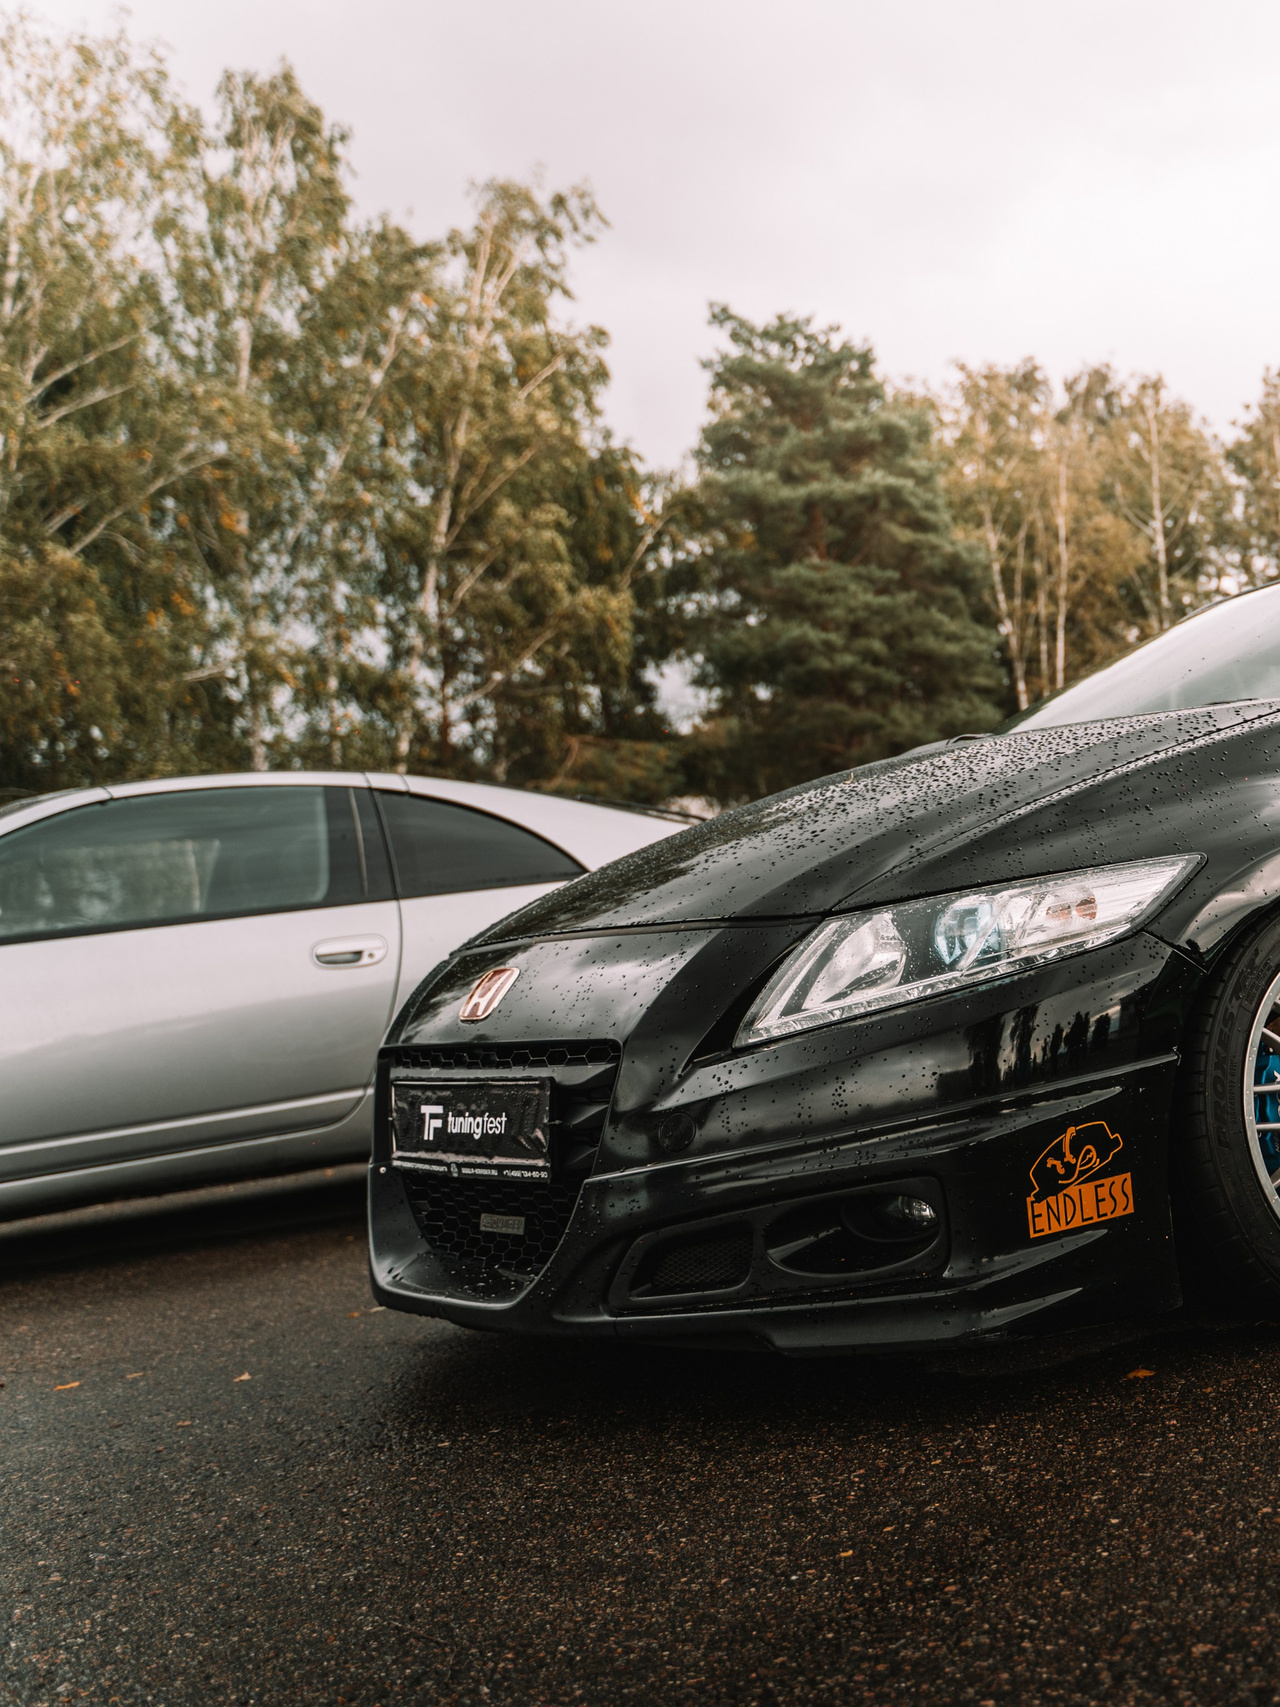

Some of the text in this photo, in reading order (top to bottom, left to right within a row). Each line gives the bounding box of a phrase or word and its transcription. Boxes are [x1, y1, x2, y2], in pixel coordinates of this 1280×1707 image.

[1212, 1007, 1236, 1150] PROXES
[420, 1105, 507, 1140] TF tuningfest
[1031, 1177, 1128, 1235] ENDLESS
